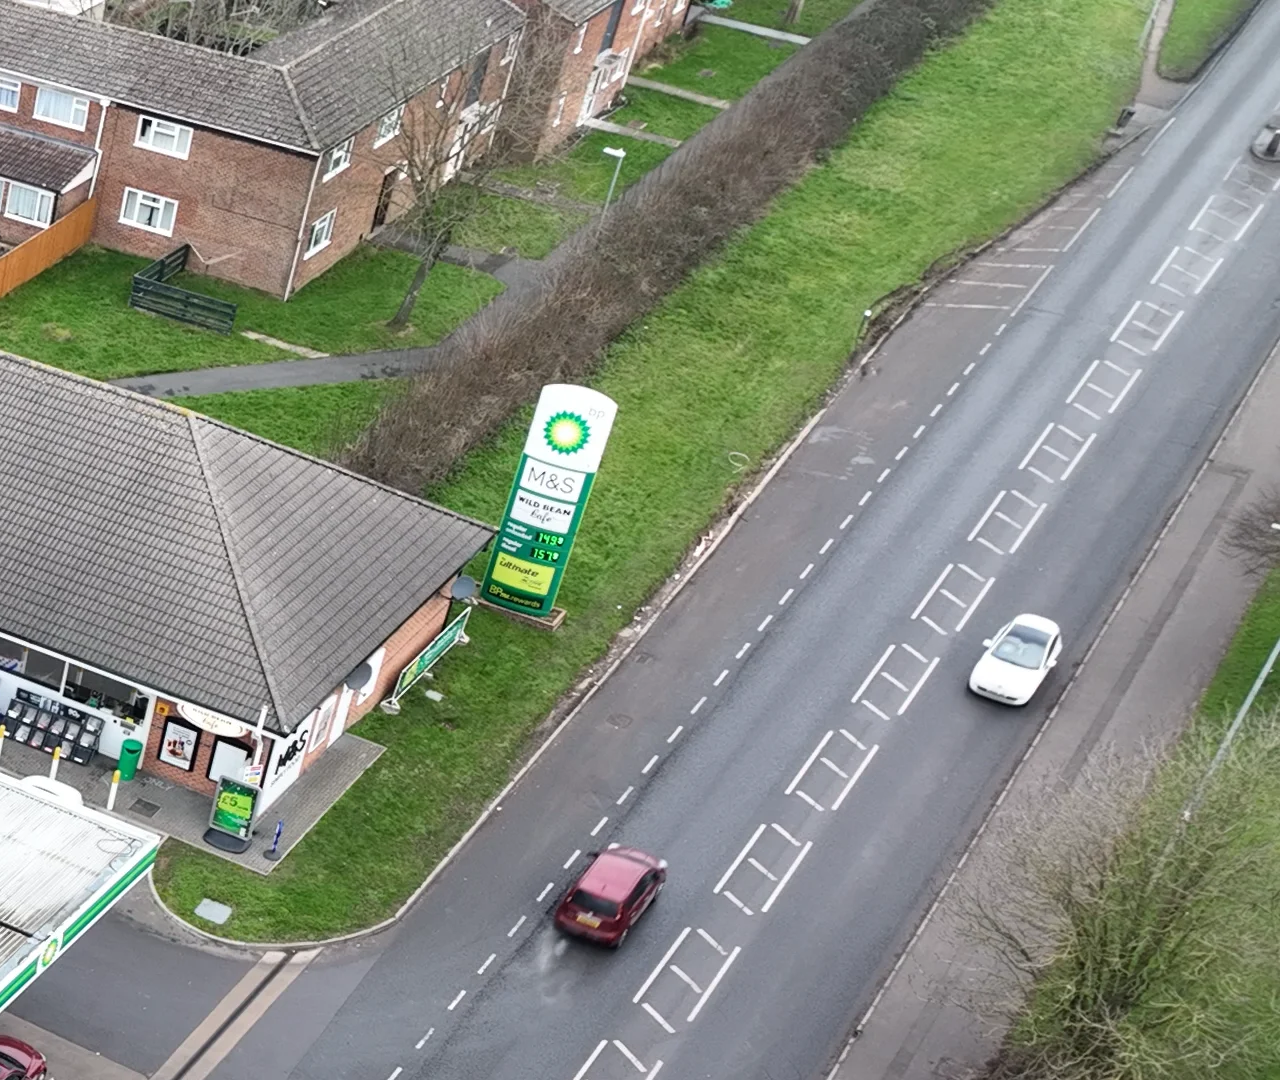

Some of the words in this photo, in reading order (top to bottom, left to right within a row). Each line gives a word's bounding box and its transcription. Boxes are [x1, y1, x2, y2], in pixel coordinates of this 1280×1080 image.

[527, 466, 576, 494] M&S
[519, 495, 541, 508] WILD
[542, 504, 572, 516] BEAN
[499, 560, 539, 577] ultimate
[221, 794, 238, 807] £5
